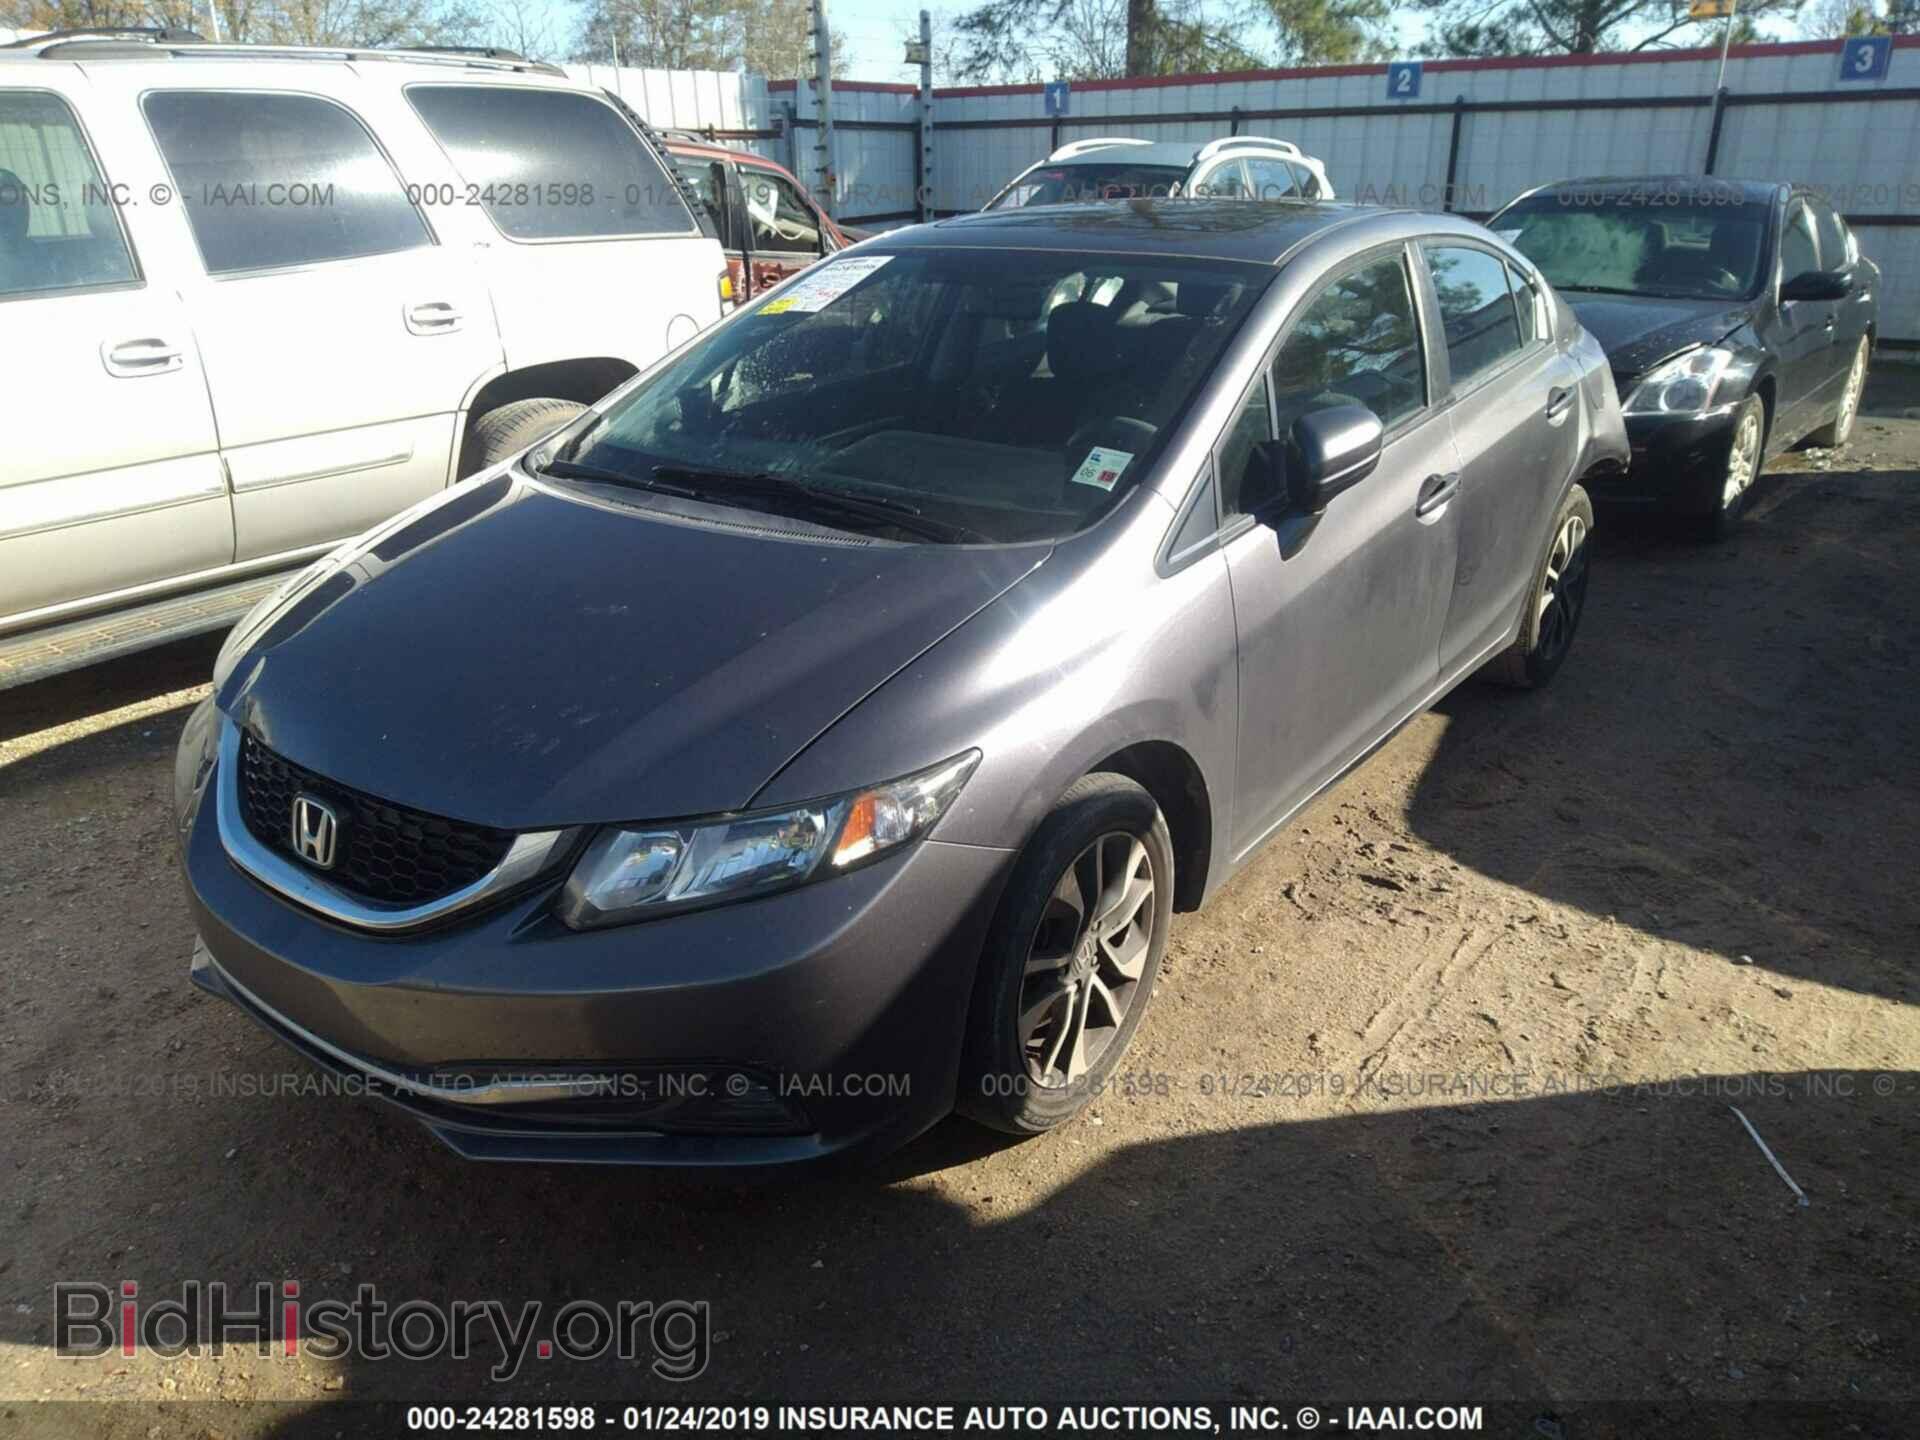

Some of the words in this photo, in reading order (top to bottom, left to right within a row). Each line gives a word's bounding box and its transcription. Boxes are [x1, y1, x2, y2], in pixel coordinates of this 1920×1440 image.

[1855, 44, 1875, 72] 3
[1397, 69, 1411, 92] 2
[1052, 87, 1062, 110] 1
